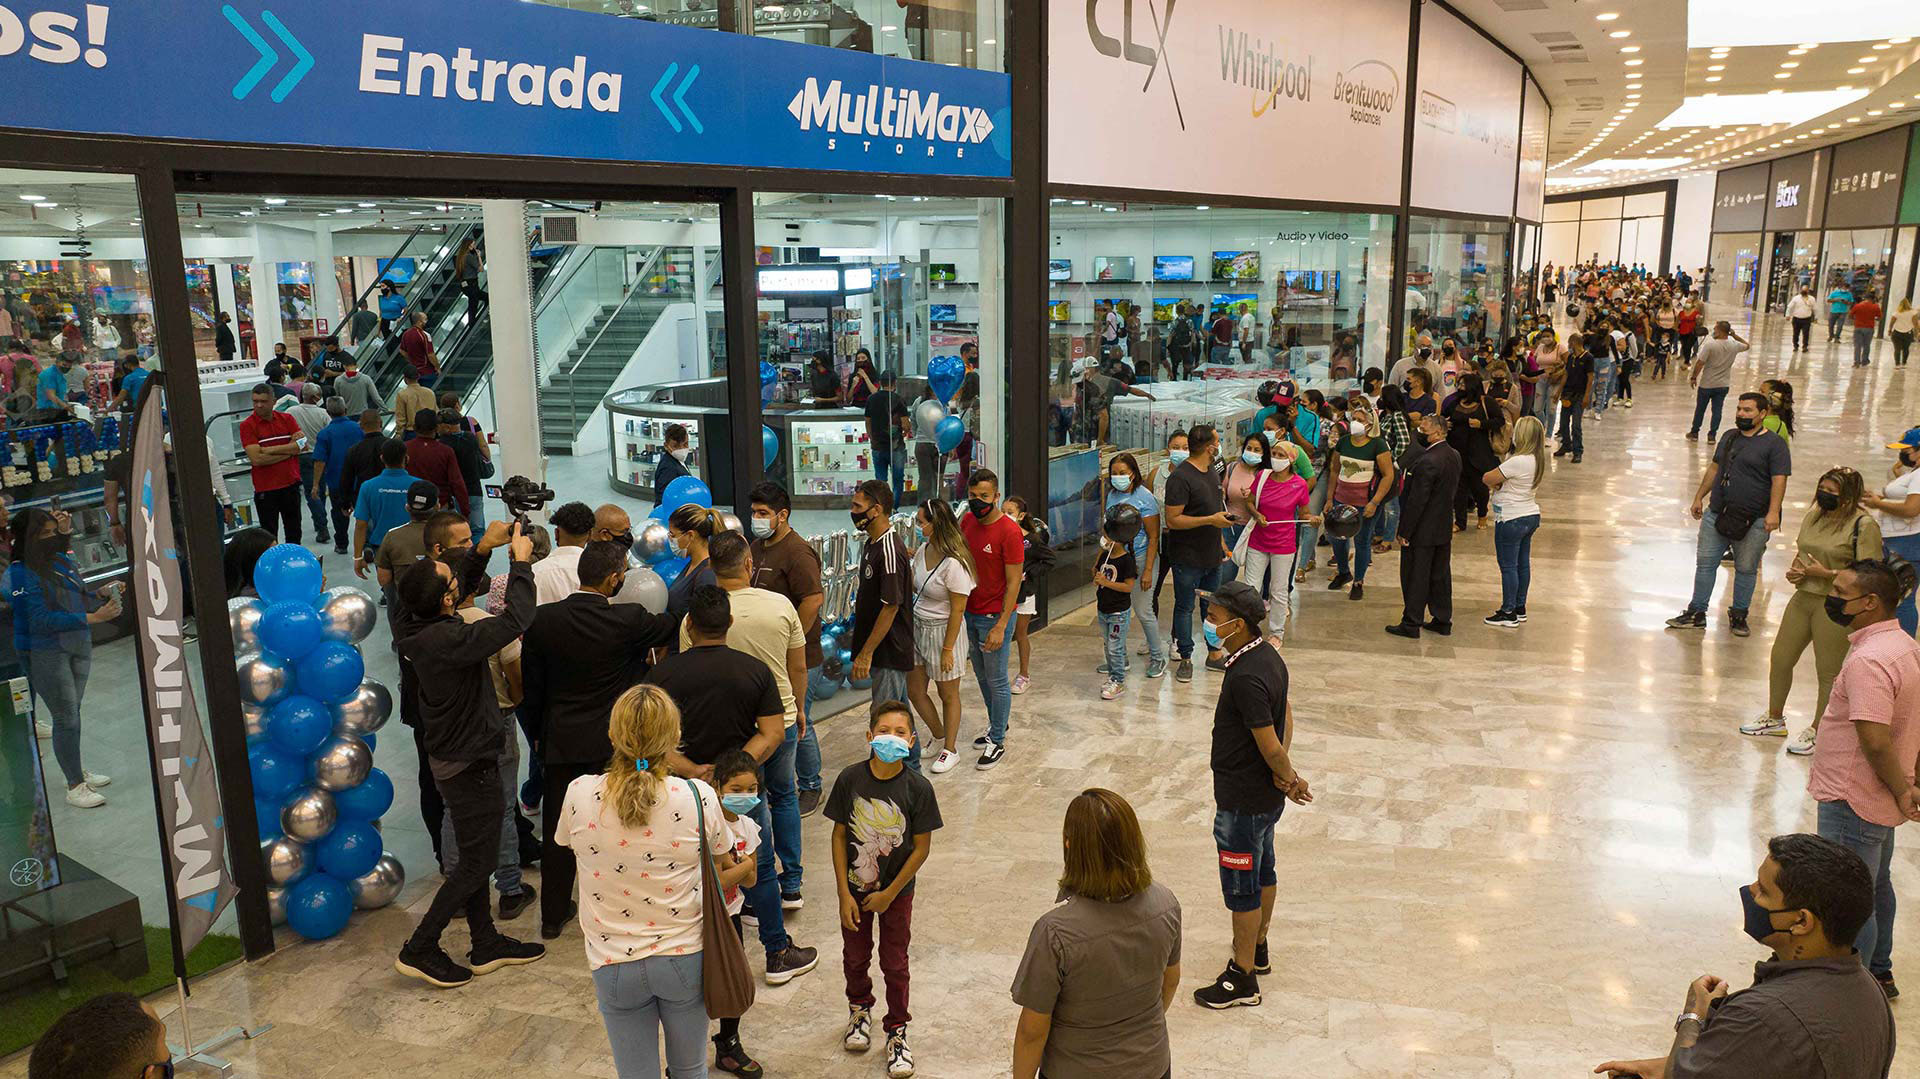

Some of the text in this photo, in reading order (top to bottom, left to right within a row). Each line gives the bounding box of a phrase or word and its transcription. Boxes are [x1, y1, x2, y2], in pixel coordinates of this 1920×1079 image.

[358, 33, 623, 112] Entrada
[1218, 24, 1313, 110] Whirlpool
[800, 77, 984, 144] MultiMax
[1334, 71, 1395, 114] Brentwood
[1349, 108, 1382, 127] Appliances
[828, 138, 963, 158] STORE
[1276, 230, 1307, 241] Audio
[1308, 232, 1316, 243] y
